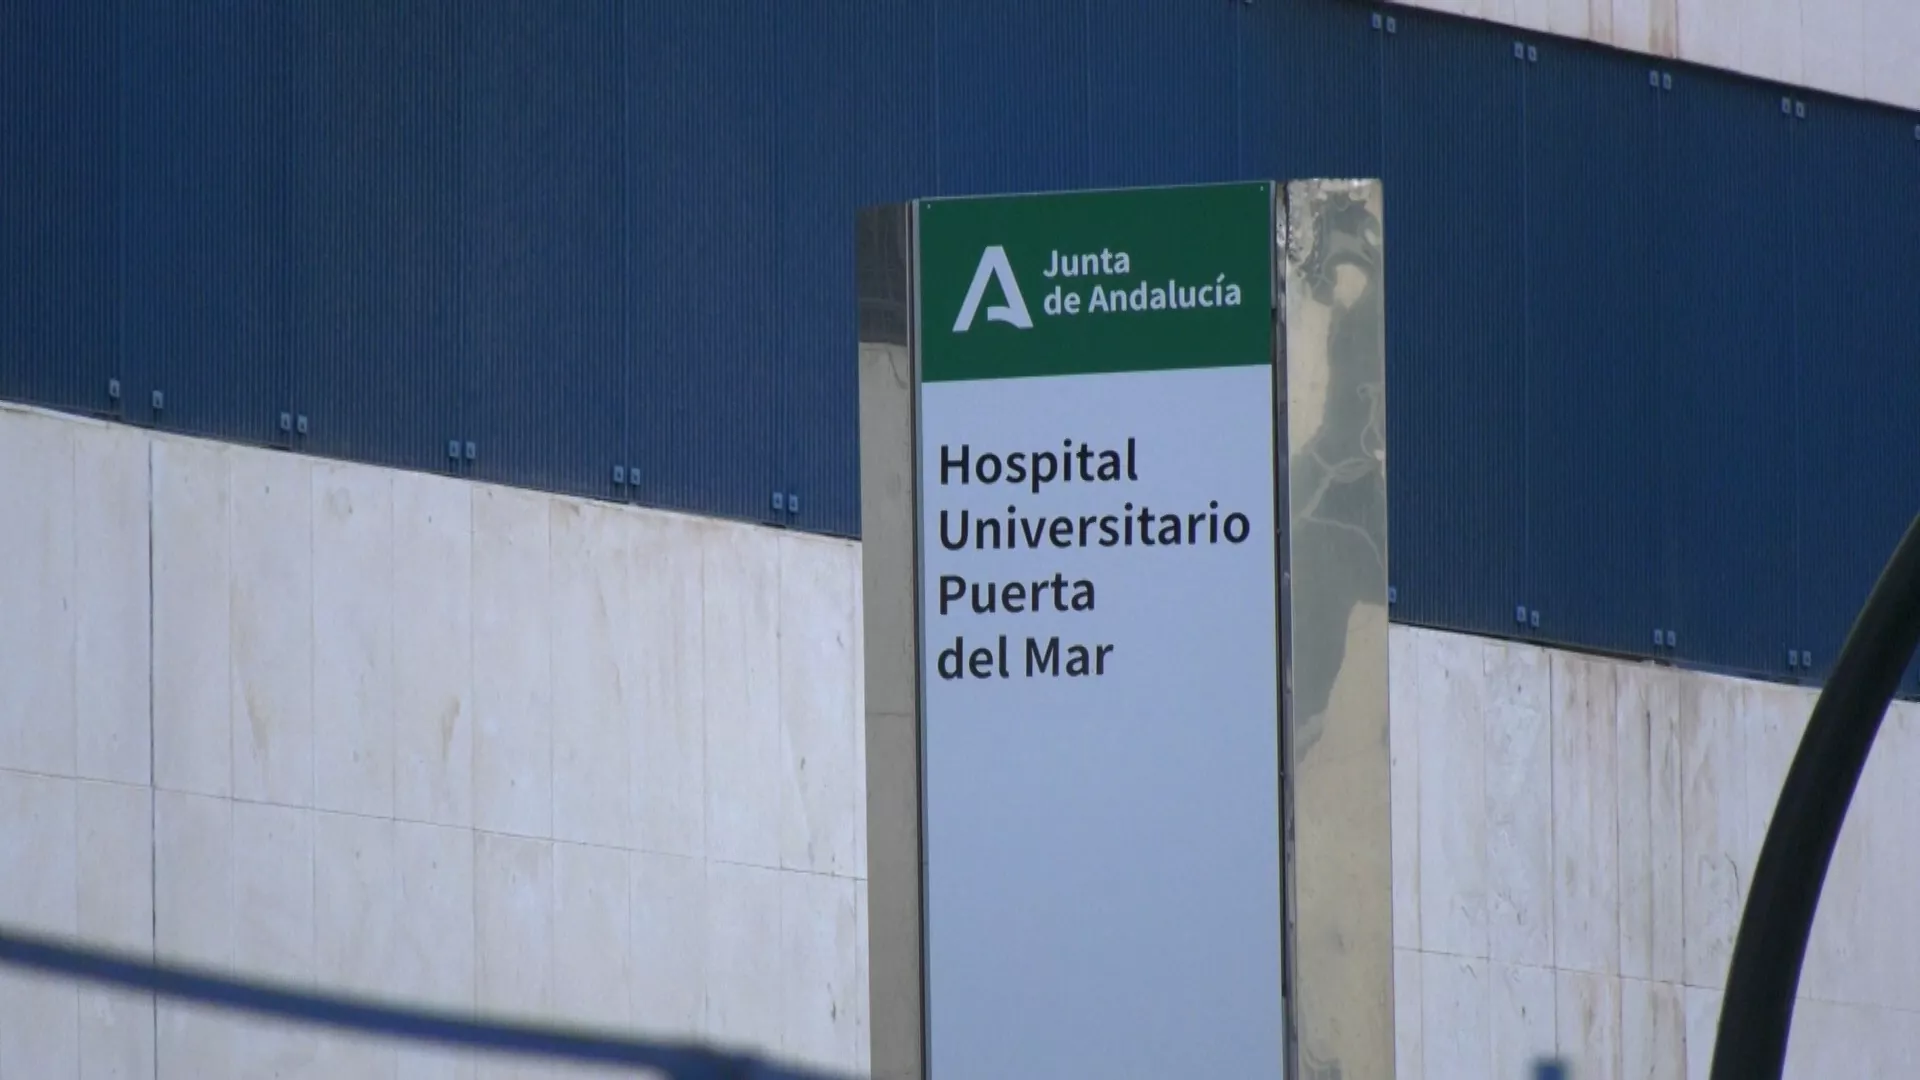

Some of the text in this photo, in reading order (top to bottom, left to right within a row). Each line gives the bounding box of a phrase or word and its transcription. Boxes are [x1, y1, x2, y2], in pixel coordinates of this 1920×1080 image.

[1042, 248, 1131, 278] Junta
[1043, 274, 1242, 315] de Andalucía
[939, 437, 1139, 495] Hospital
[939, 500, 1251, 552] Universitario
[939, 573, 1095, 616] Puerta
[937, 635, 1116, 681] del Mar
